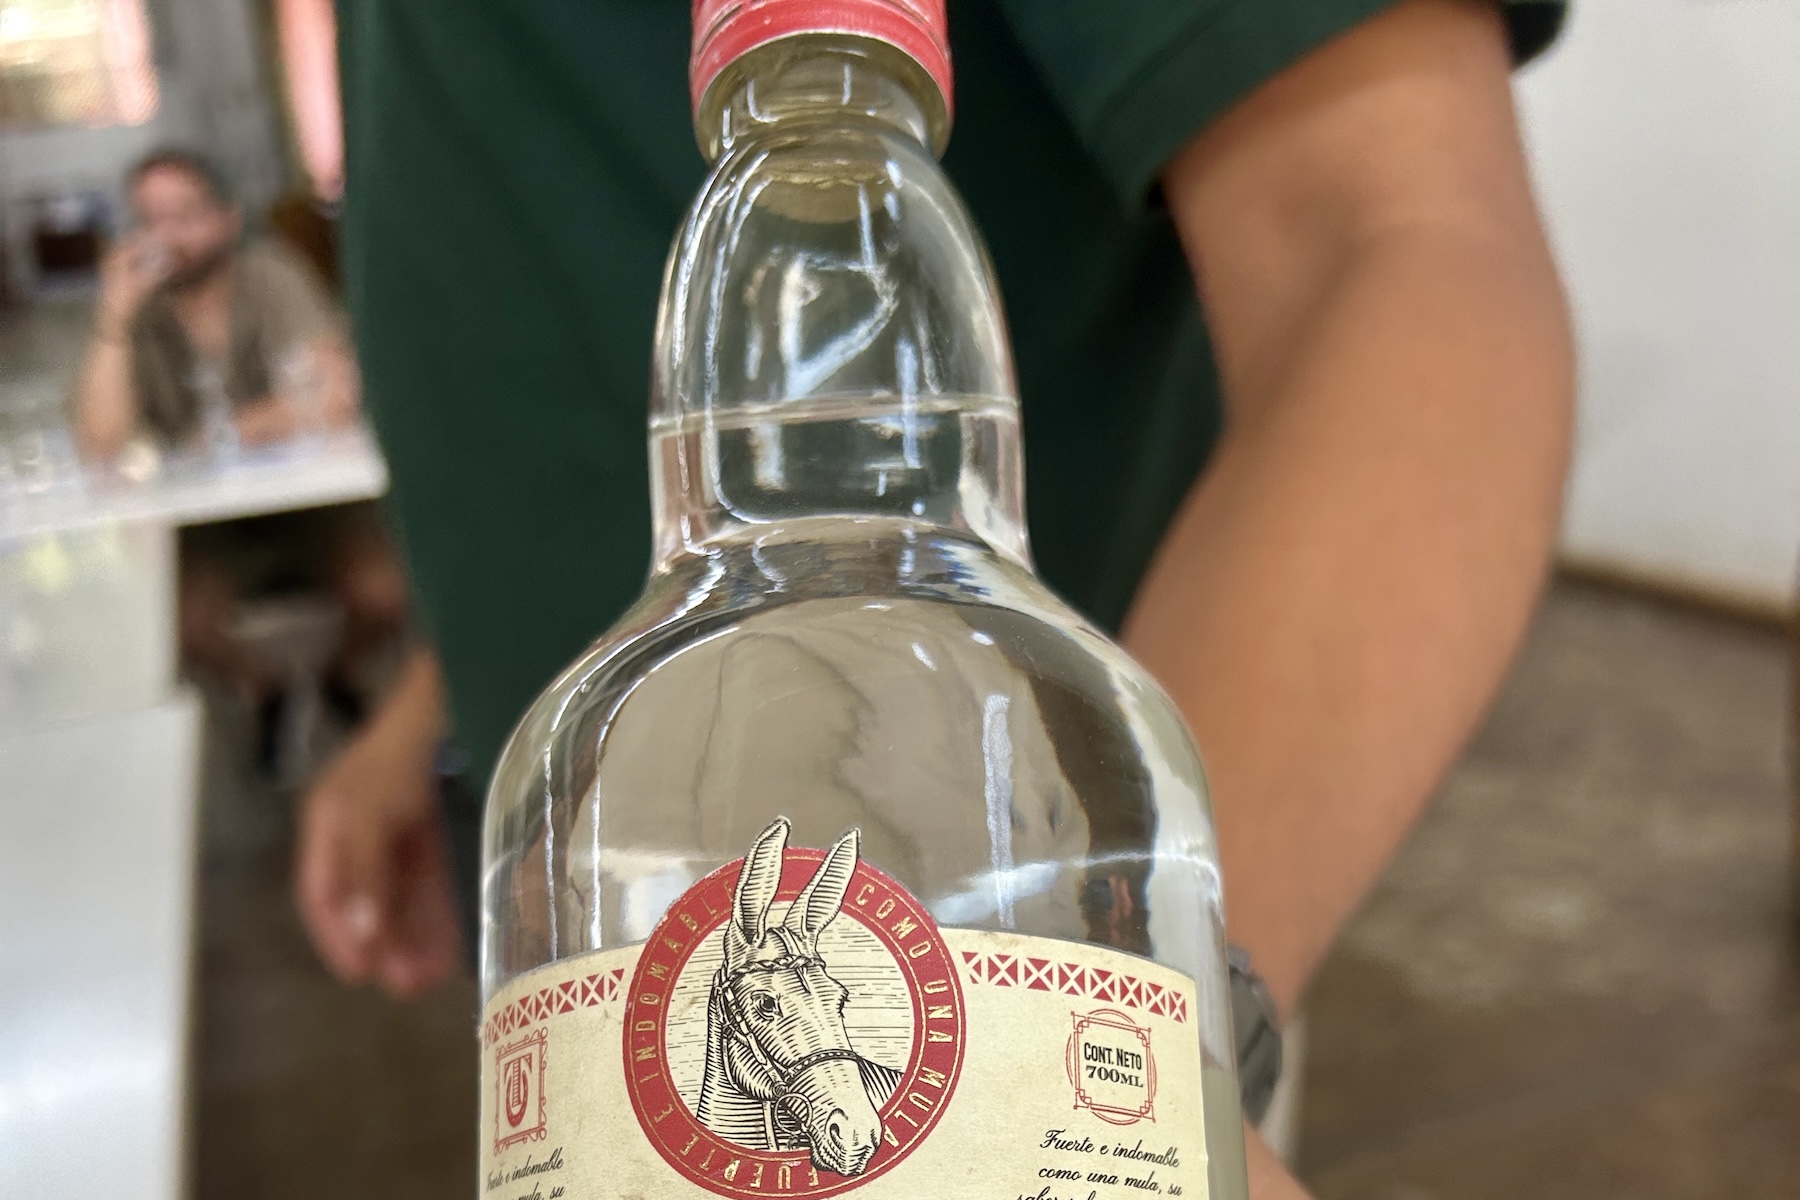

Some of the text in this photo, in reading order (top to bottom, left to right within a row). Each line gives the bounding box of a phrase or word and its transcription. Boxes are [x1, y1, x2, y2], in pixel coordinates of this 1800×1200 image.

[855, 884, 931, 958] COMO
[923, 979, 954, 1043] UNA
[1084, 1042, 1142, 1070] CONT. NETO
[883, 1067, 946, 1148] MULA
[511, 1147, 564, 1181] indomable
[680, 1132, 819, 1189] FUERTE
[1040, 1129, 1179, 1168] Fuerte e indomable
[549, 1186, 564, 1200] su
[1038, 1167, 1182, 1197] como una mula, su
